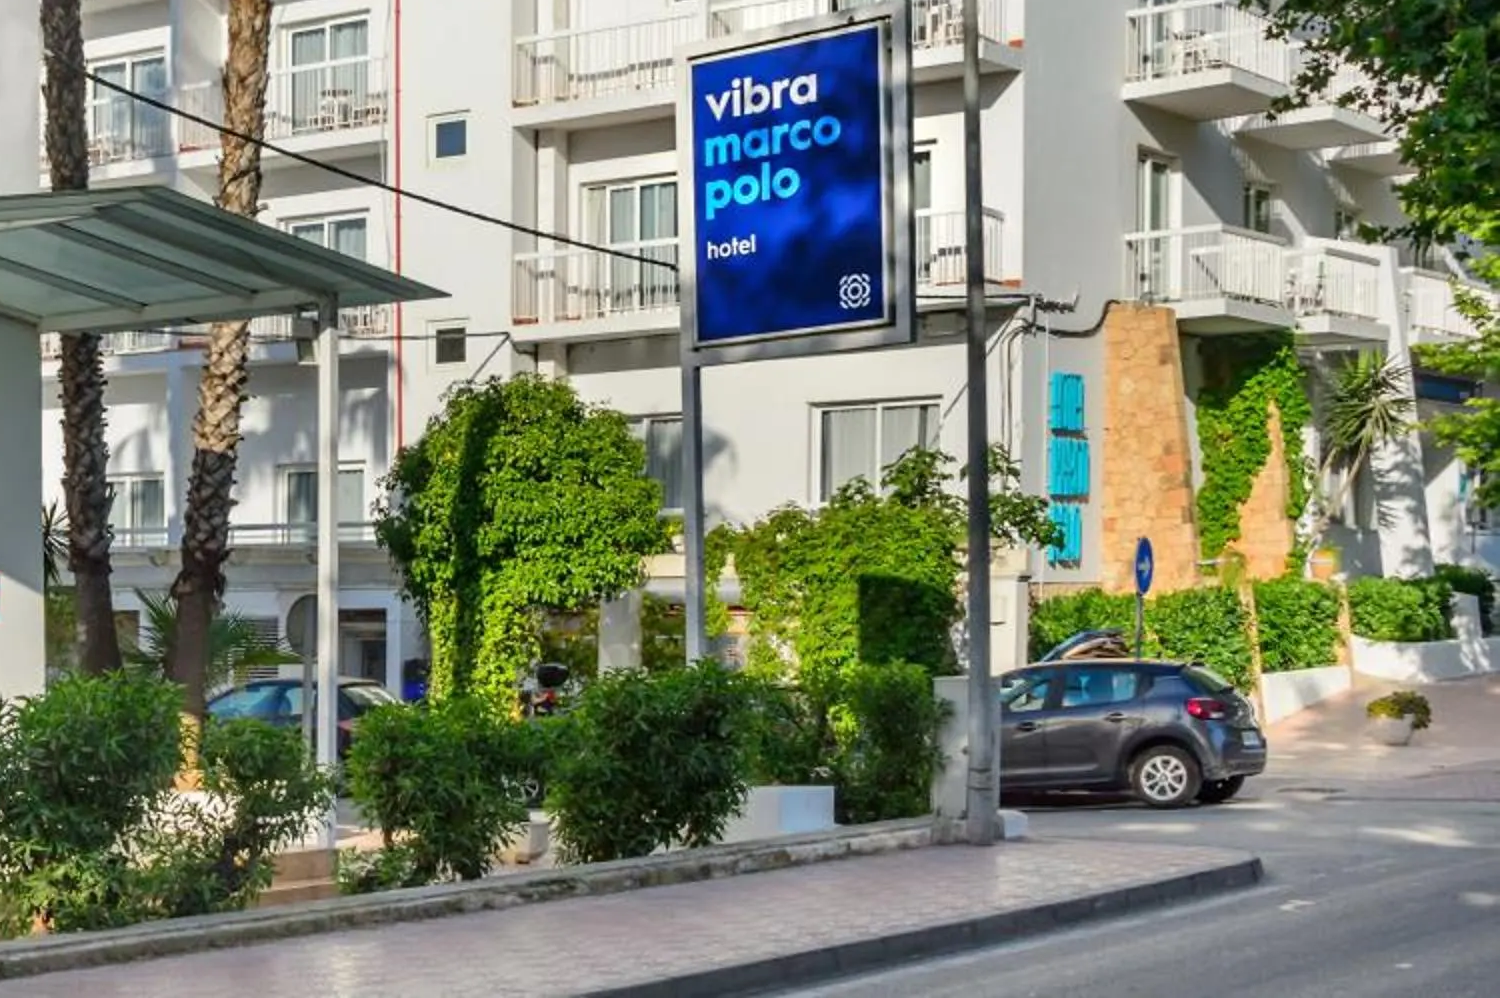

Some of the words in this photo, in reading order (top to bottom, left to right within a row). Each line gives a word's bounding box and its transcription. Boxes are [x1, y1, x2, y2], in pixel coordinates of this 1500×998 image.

[706, 73, 817, 121] vibra
[705, 115, 841, 167] marco
[705, 162, 800, 220] polo
[707, 234, 756, 259] hotel
